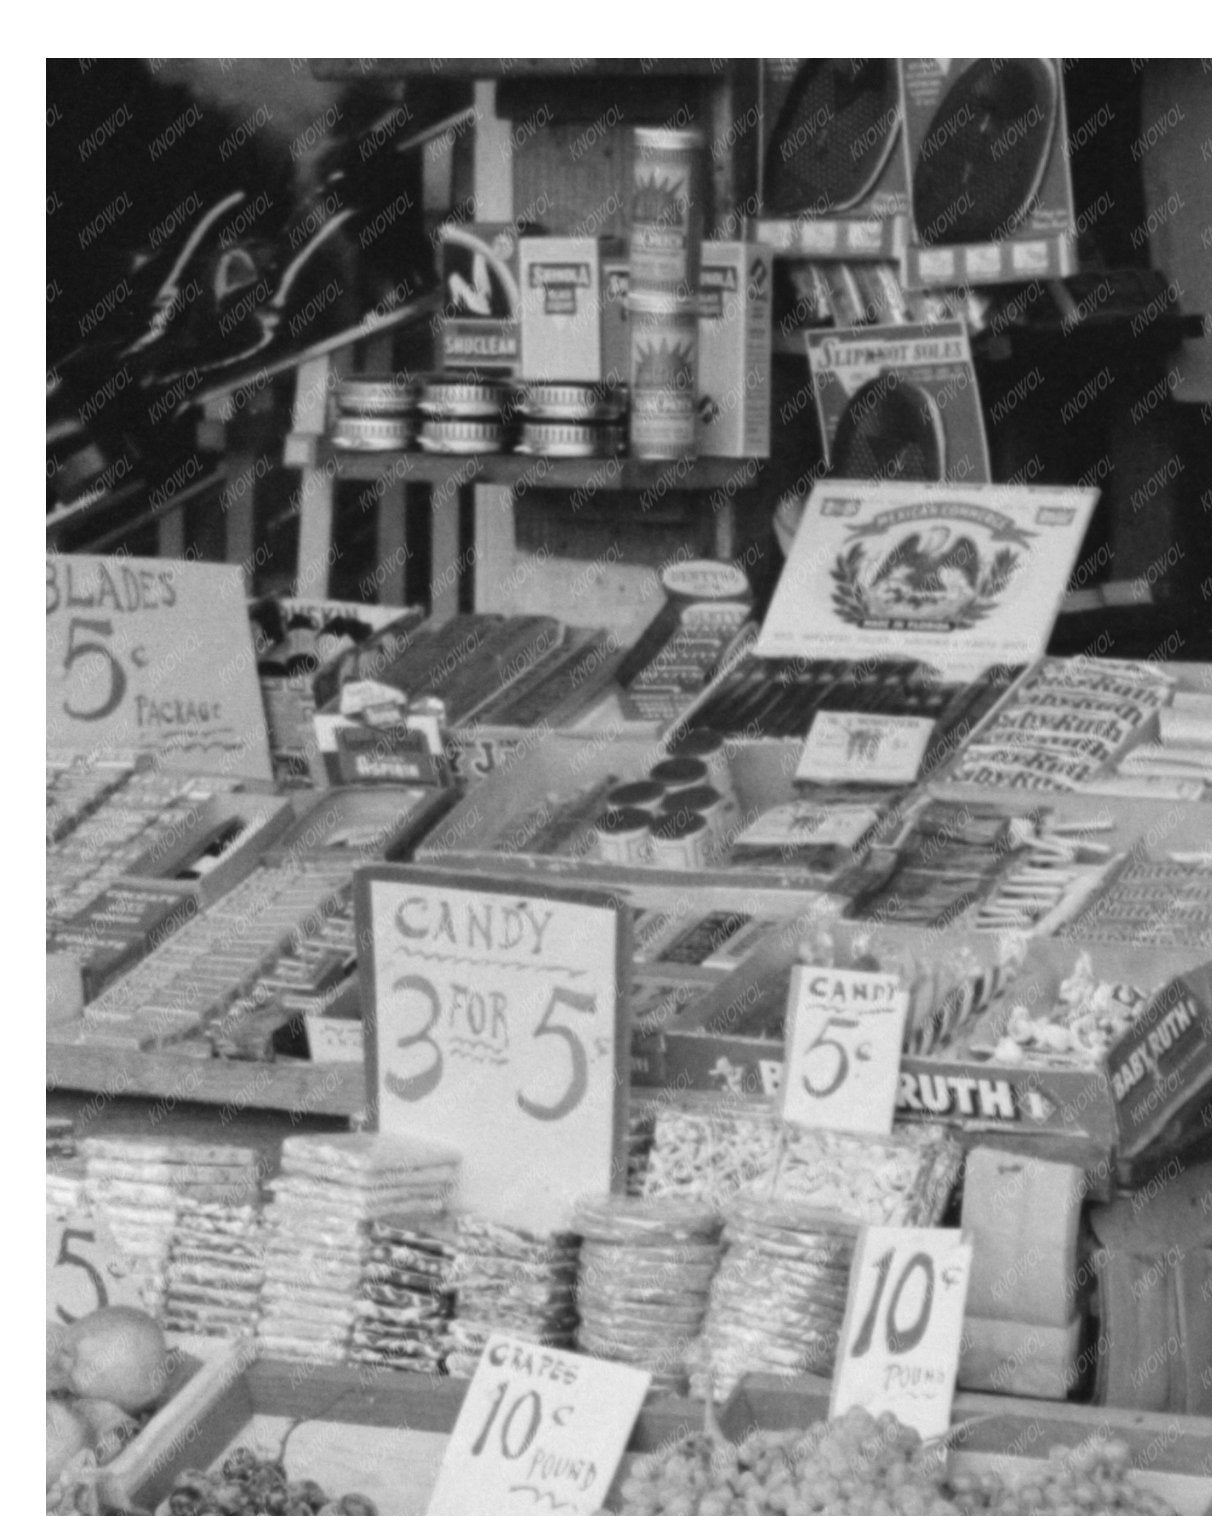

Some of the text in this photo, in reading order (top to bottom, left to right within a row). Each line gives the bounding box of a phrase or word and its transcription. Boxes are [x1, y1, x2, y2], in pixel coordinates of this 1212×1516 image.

[394, 897, 555, 955] CANDY
[384, 974, 444, 1104] 3
[449, 982, 510, 1048] FOR
[526, 1447, 598, 1492] POUND
